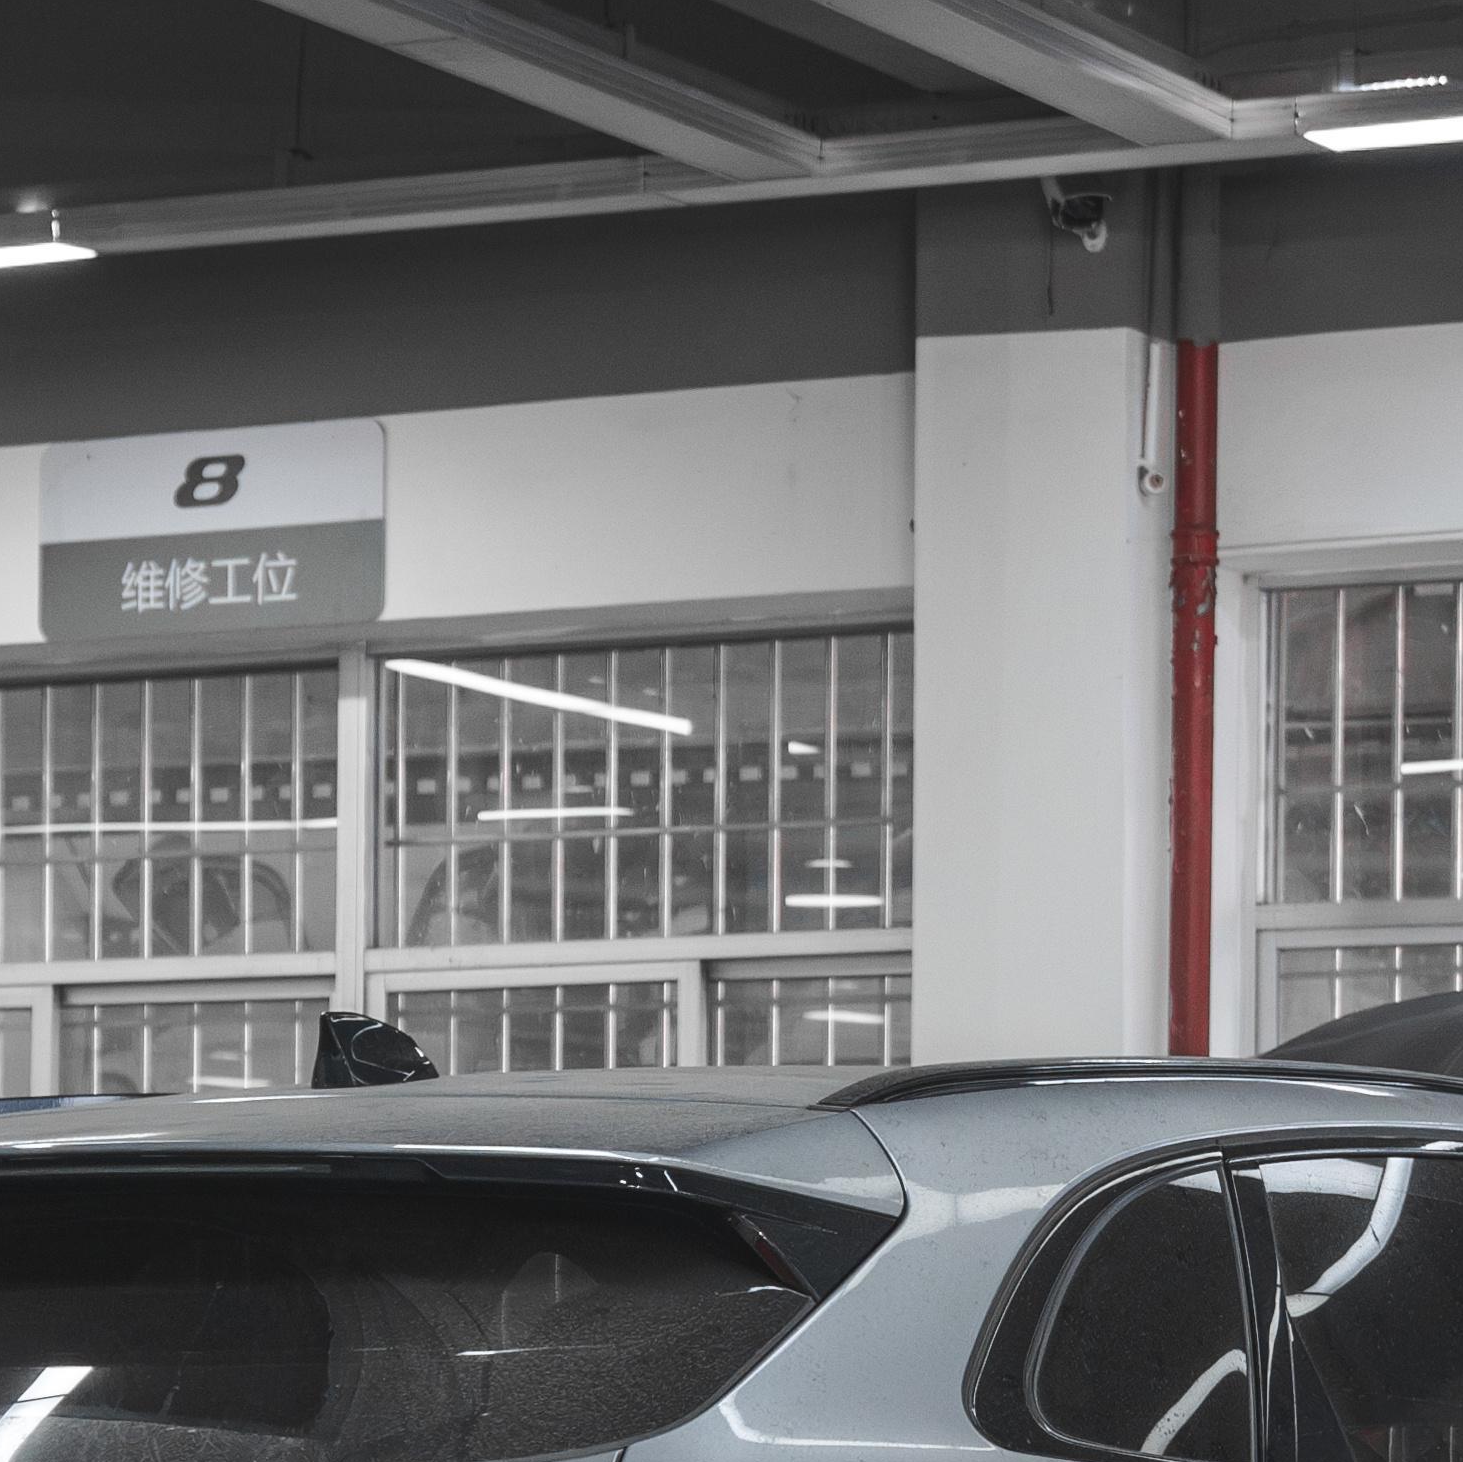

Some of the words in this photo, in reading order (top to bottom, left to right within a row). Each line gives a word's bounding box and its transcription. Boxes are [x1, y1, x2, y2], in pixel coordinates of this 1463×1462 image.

[173, 454, 246, 509] 8
[120, 551, 299, 614] 维修工位
